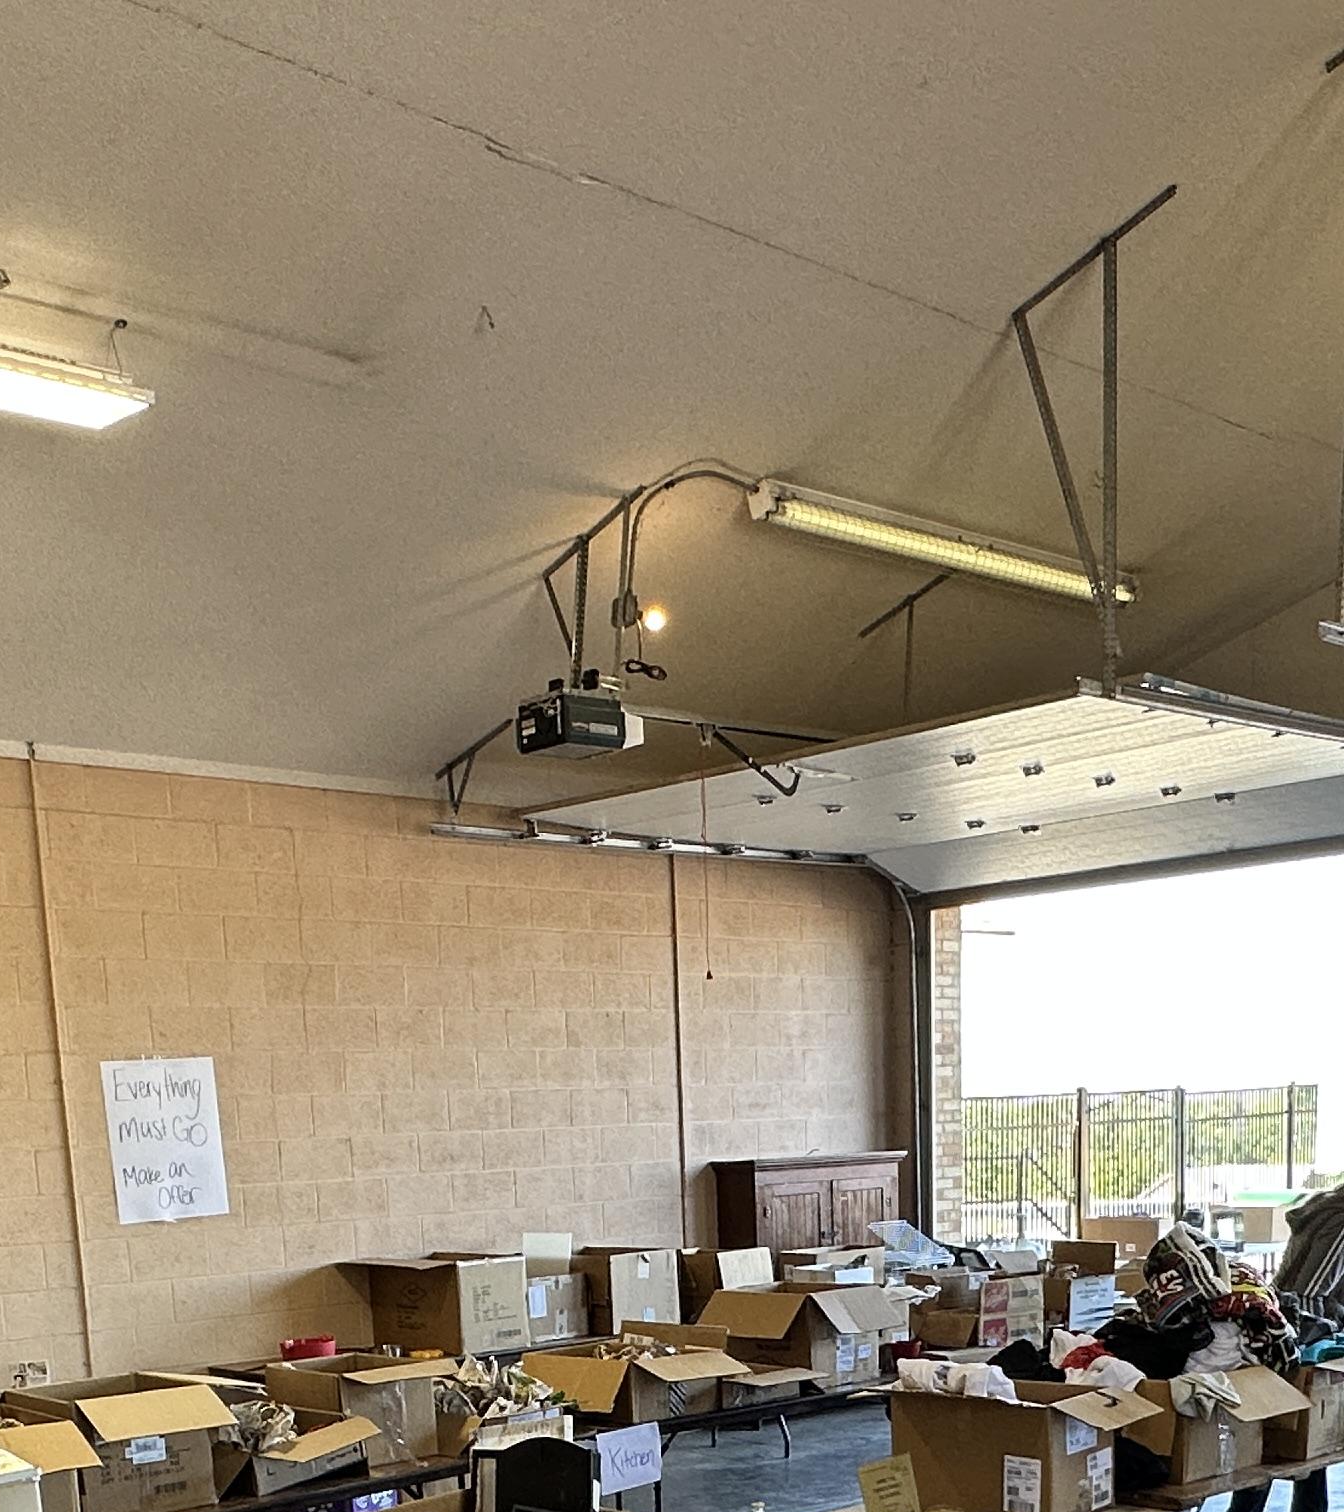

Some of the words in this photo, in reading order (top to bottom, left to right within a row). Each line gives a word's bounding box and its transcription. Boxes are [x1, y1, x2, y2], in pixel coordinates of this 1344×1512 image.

[113, 1067, 201, 1120] Everything
[122, 1165, 164, 1188] Make
[169, 1162, 193, 1179] an
[158, 1184, 202, 1209] Offer
[608, 1447, 656, 1479] Kitchen
